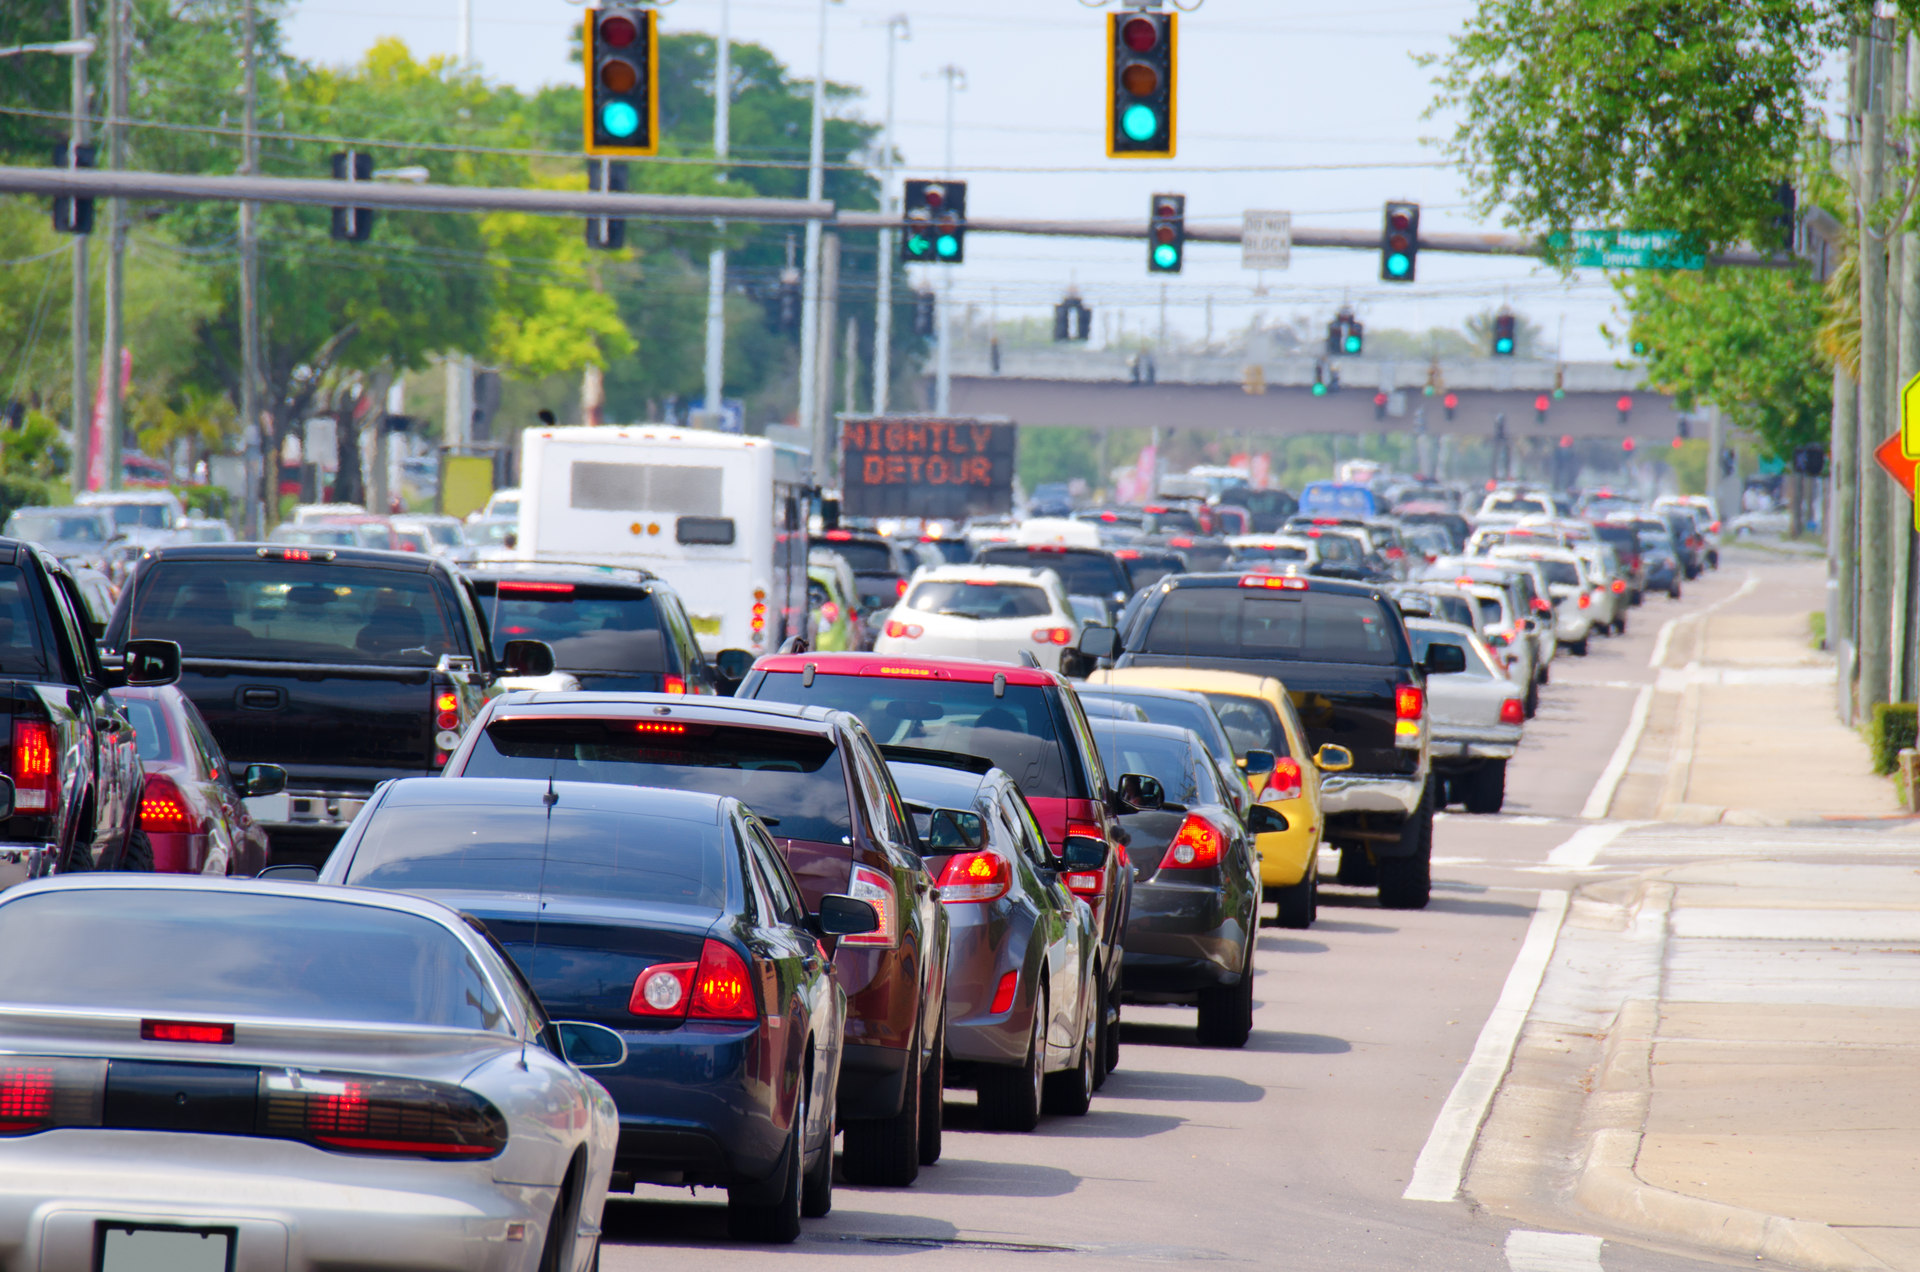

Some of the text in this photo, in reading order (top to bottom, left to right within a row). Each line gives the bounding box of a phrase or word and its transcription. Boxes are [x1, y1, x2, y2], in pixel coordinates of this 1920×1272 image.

[1246, 218, 1288, 232] DO NOT
[1246, 235, 1287, 251] BLOCK
[1602, 252, 1641, 266] DRIVE
[843, 422, 992, 453] NIGHTLY
[862, 454, 992, 486] DETOUR
